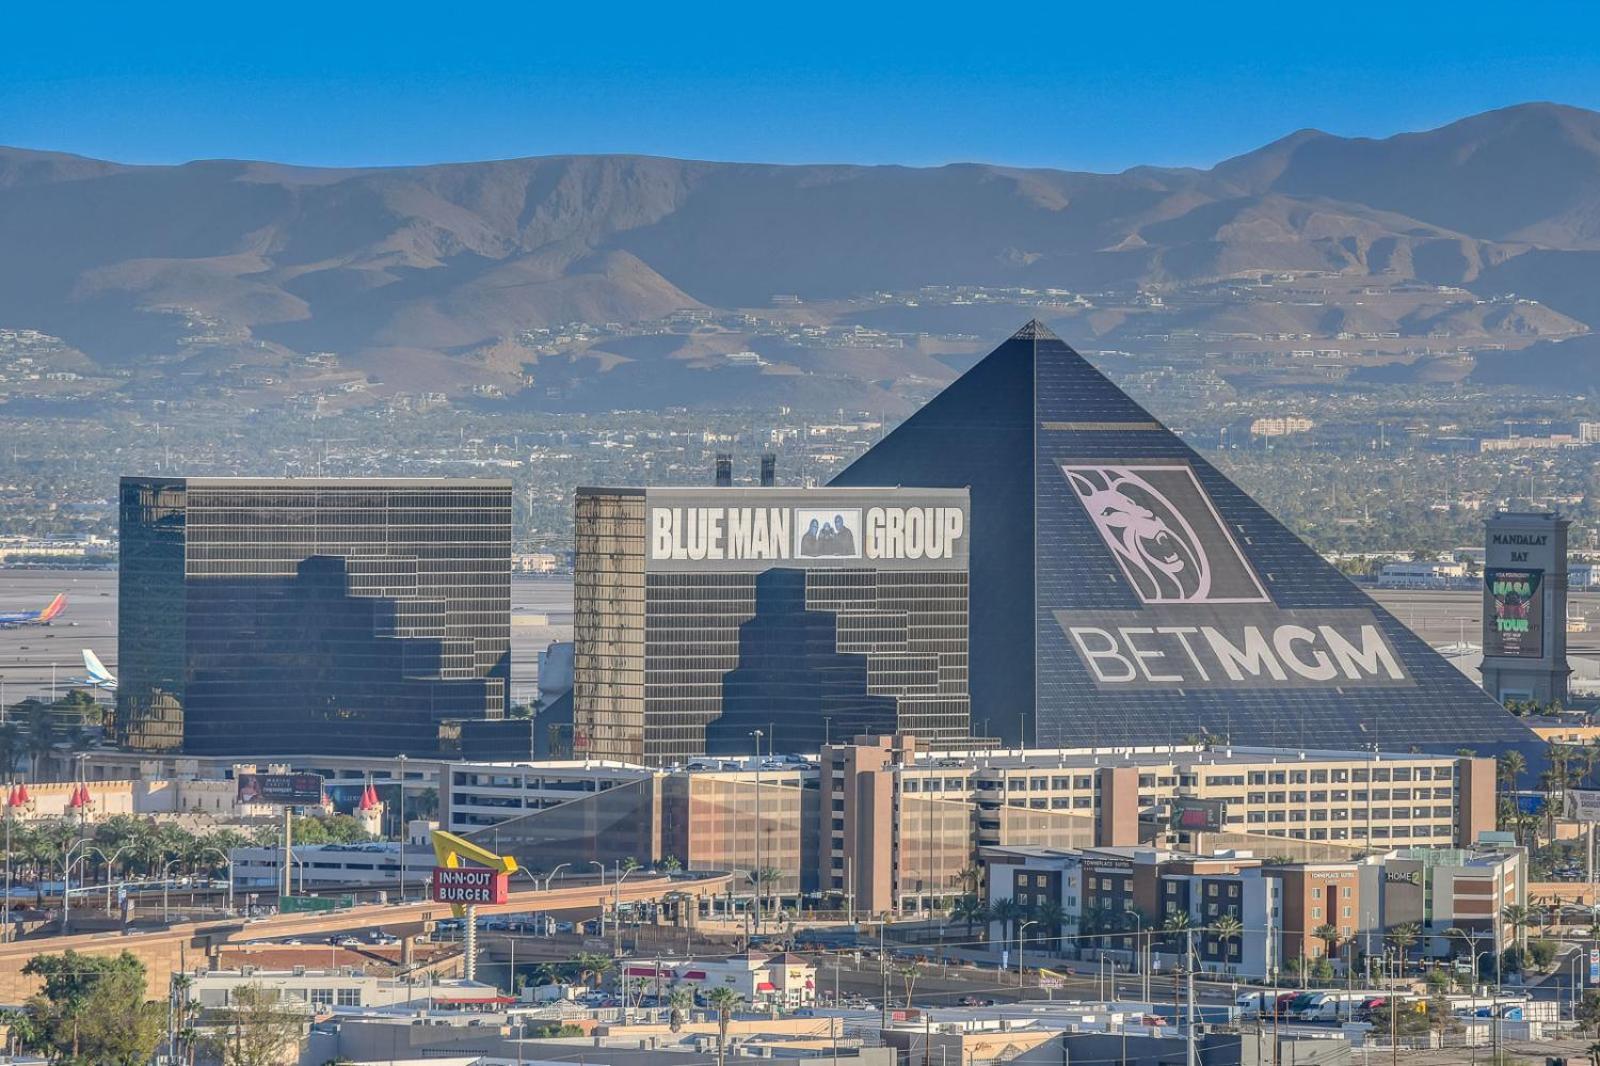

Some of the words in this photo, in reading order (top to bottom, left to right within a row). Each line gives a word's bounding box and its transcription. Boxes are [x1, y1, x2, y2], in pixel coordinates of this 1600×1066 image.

[652, 507, 724, 560] BLUE
[728, 507, 790, 560] MAN
[866, 507, 963, 559] GROUP
[1493, 534, 1548, 546] MANDALAY
[1511, 551, 1529, 562] BAY
[1496, 618, 1529, 632] TOUR
[1069, 625, 1405, 682] BETMGM
[440, 872, 491, 885] IN-N-OUT
[440, 888, 490, 901] BURGER
